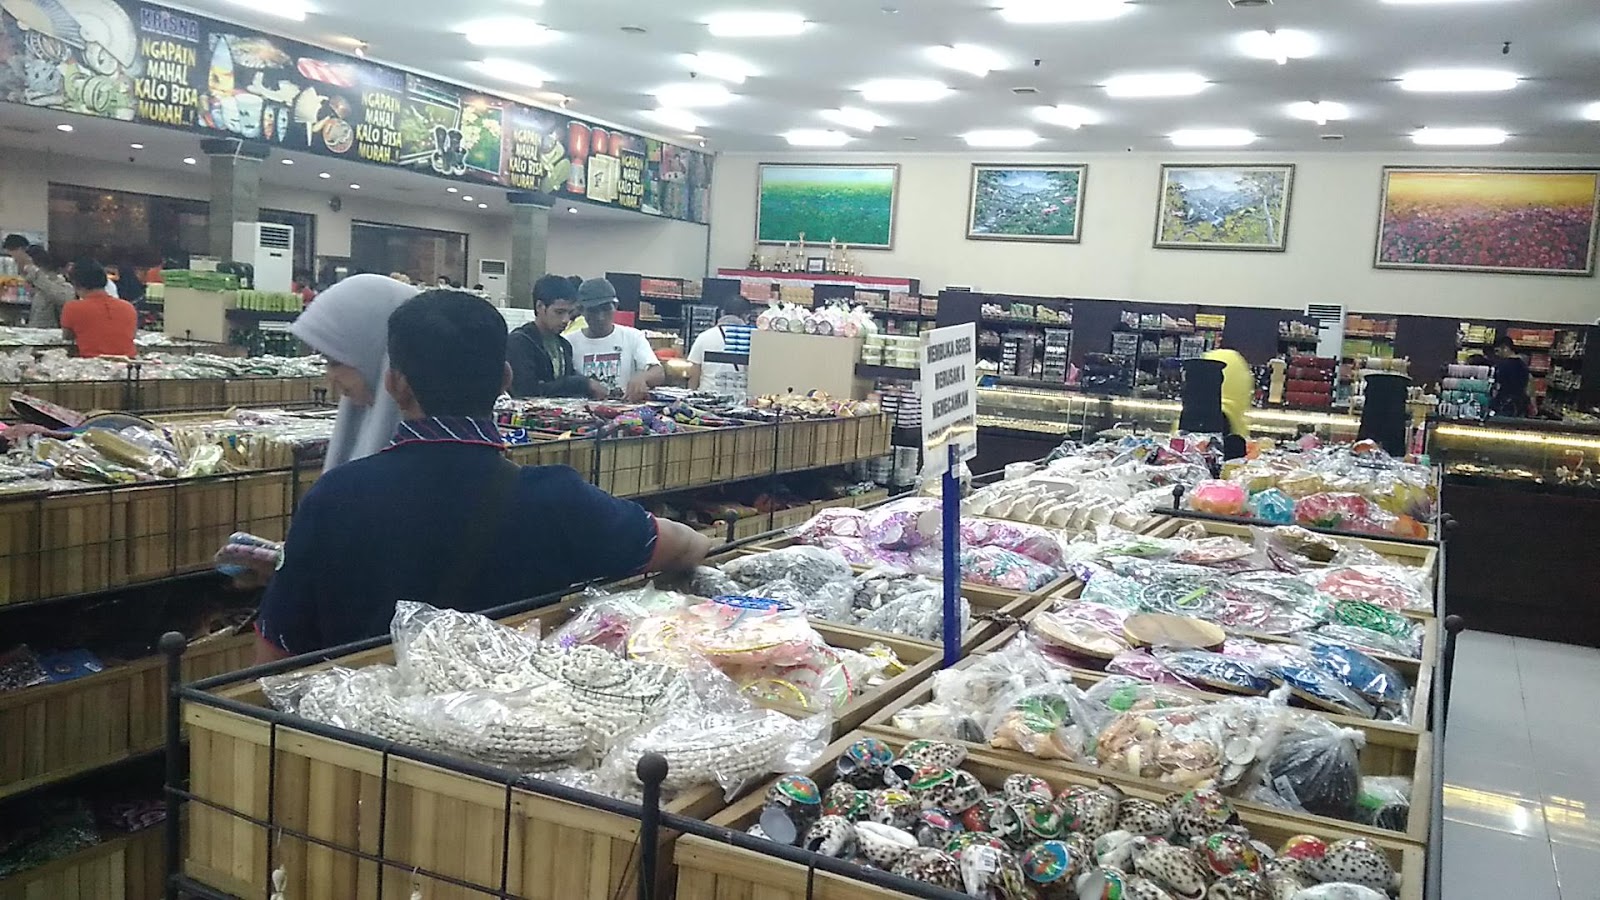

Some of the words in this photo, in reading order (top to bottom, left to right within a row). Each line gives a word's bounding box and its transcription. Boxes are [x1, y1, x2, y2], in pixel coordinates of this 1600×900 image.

[142, 38, 196, 66] NGAPAIN
[147, 60, 188, 85] MAHAL
[135, 78, 168, 100] KALO
[171, 84, 199, 106] BISA
[361, 90, 401, 112] NGAPAIN
[365, 108, 395, 129] MAHAL
[356, 124, 380, 143] KALO
[382, 129, 402, 148] BISA
[509, 157, 526, 172] KALO
[528, 160, 543, 176] BISA
[927, 340, 955, 364] MEMBUKA
[955, 336, 971, 356] SEGEL
[935, 366, 960, 390] MERUSAK
[932, 390, 969, 419] MEMECAHKAN
